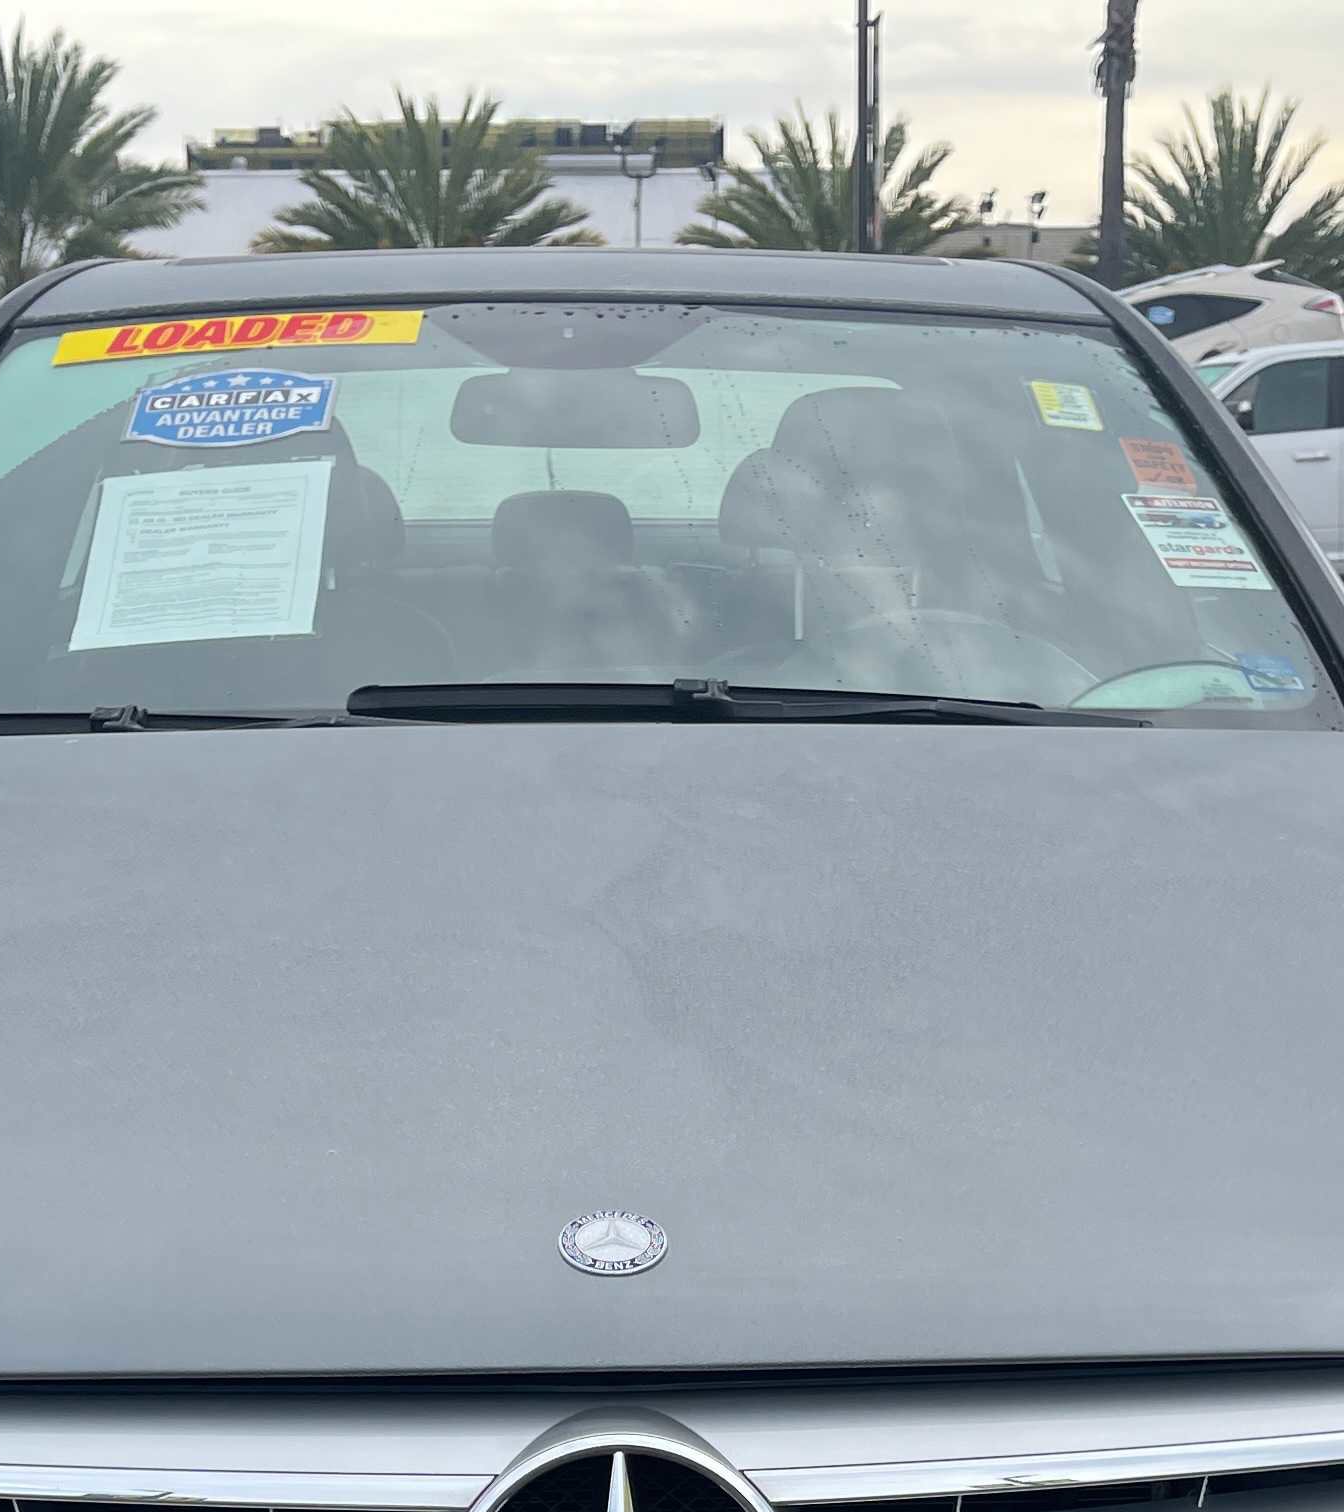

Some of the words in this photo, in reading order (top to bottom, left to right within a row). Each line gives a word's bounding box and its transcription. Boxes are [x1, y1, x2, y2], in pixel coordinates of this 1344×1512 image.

[106, 313, 375, 355] LOADED
[149, 388, 320, 411] CARFAX
[156, 406, 303, 427] ADVANTAGE
[177, 420, 273, 440] DEALER
[594, 1259, 635, 1270] BENZ
